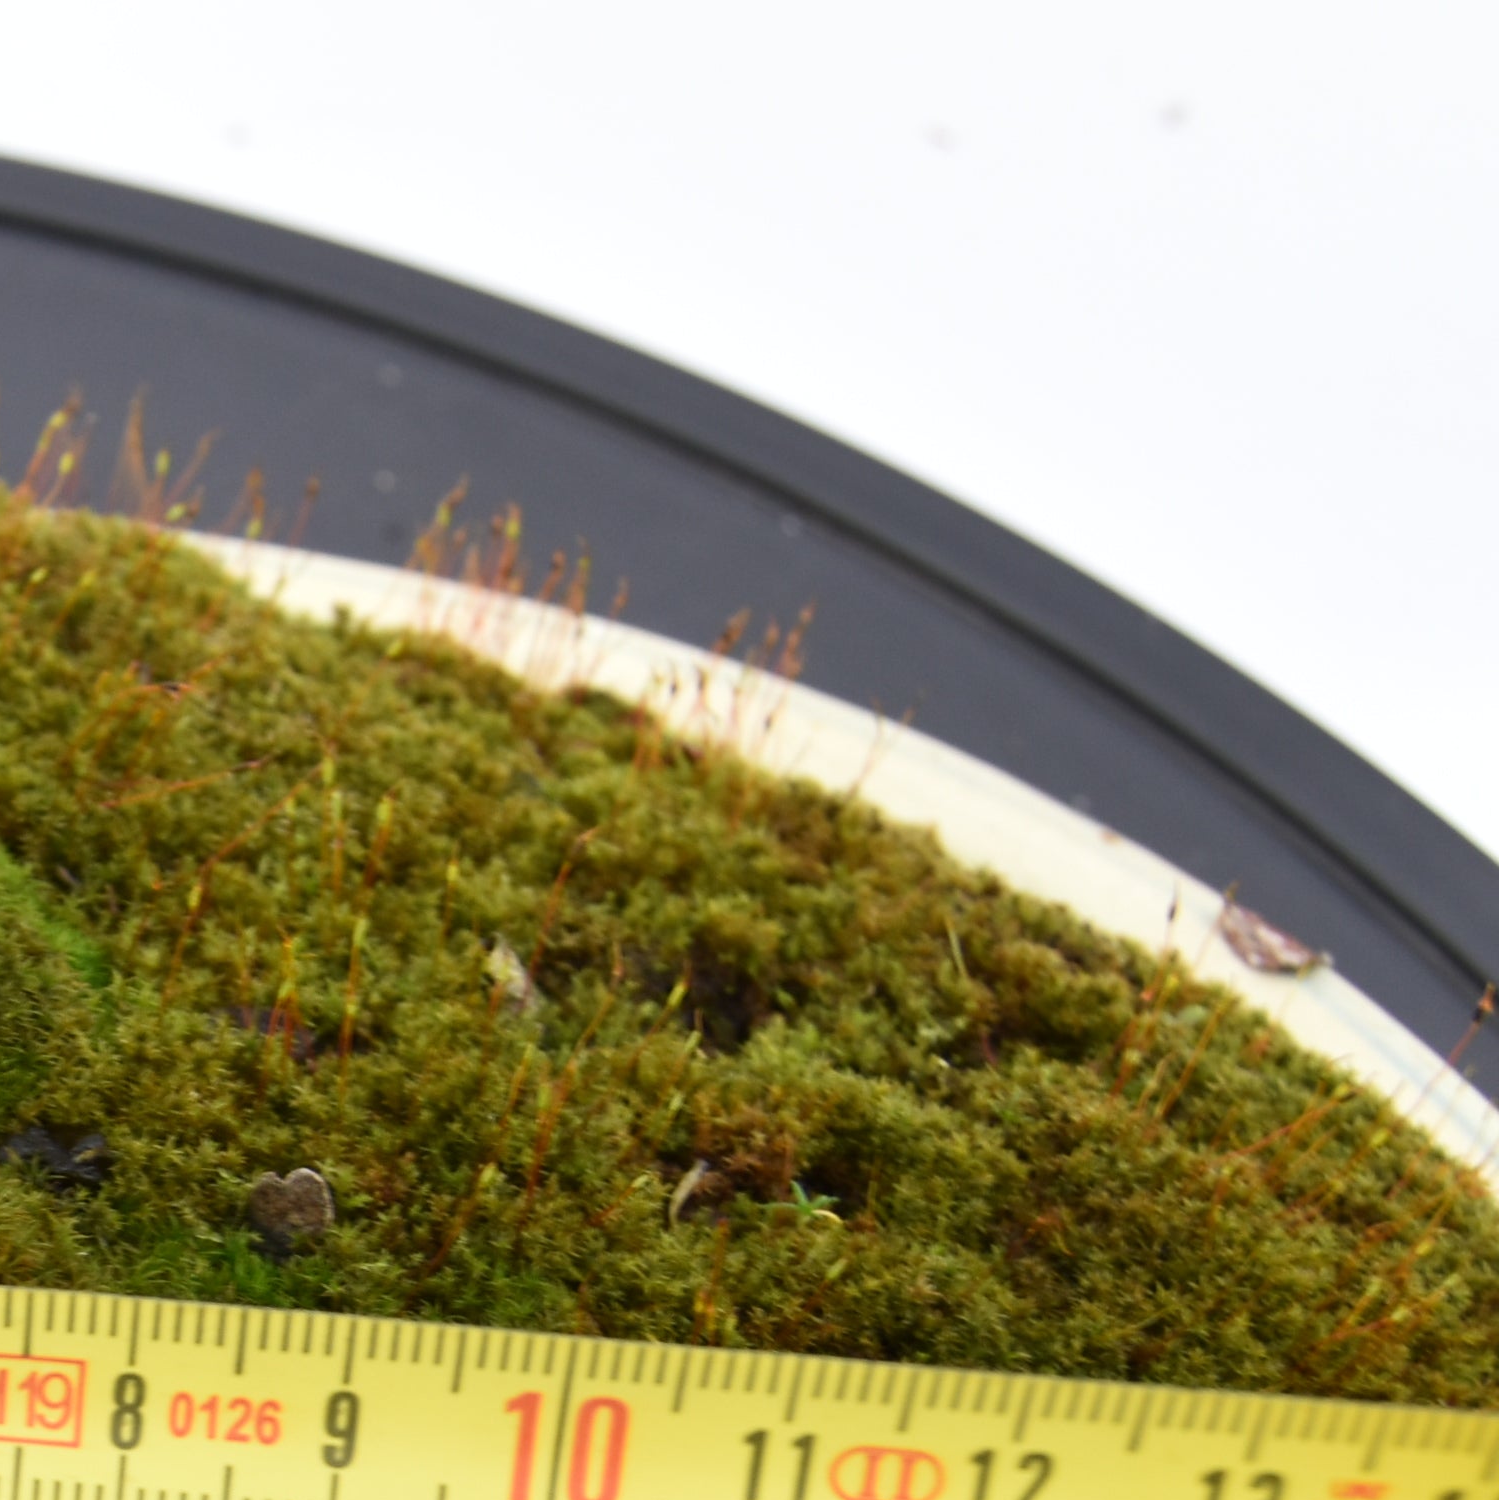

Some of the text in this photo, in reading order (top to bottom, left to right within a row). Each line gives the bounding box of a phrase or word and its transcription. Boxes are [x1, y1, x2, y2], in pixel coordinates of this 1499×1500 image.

[111, 1373, 146, 1450] 8
[169, 1392, 283, 1446] 0126
[323, 1391, 360, 1468] 9
